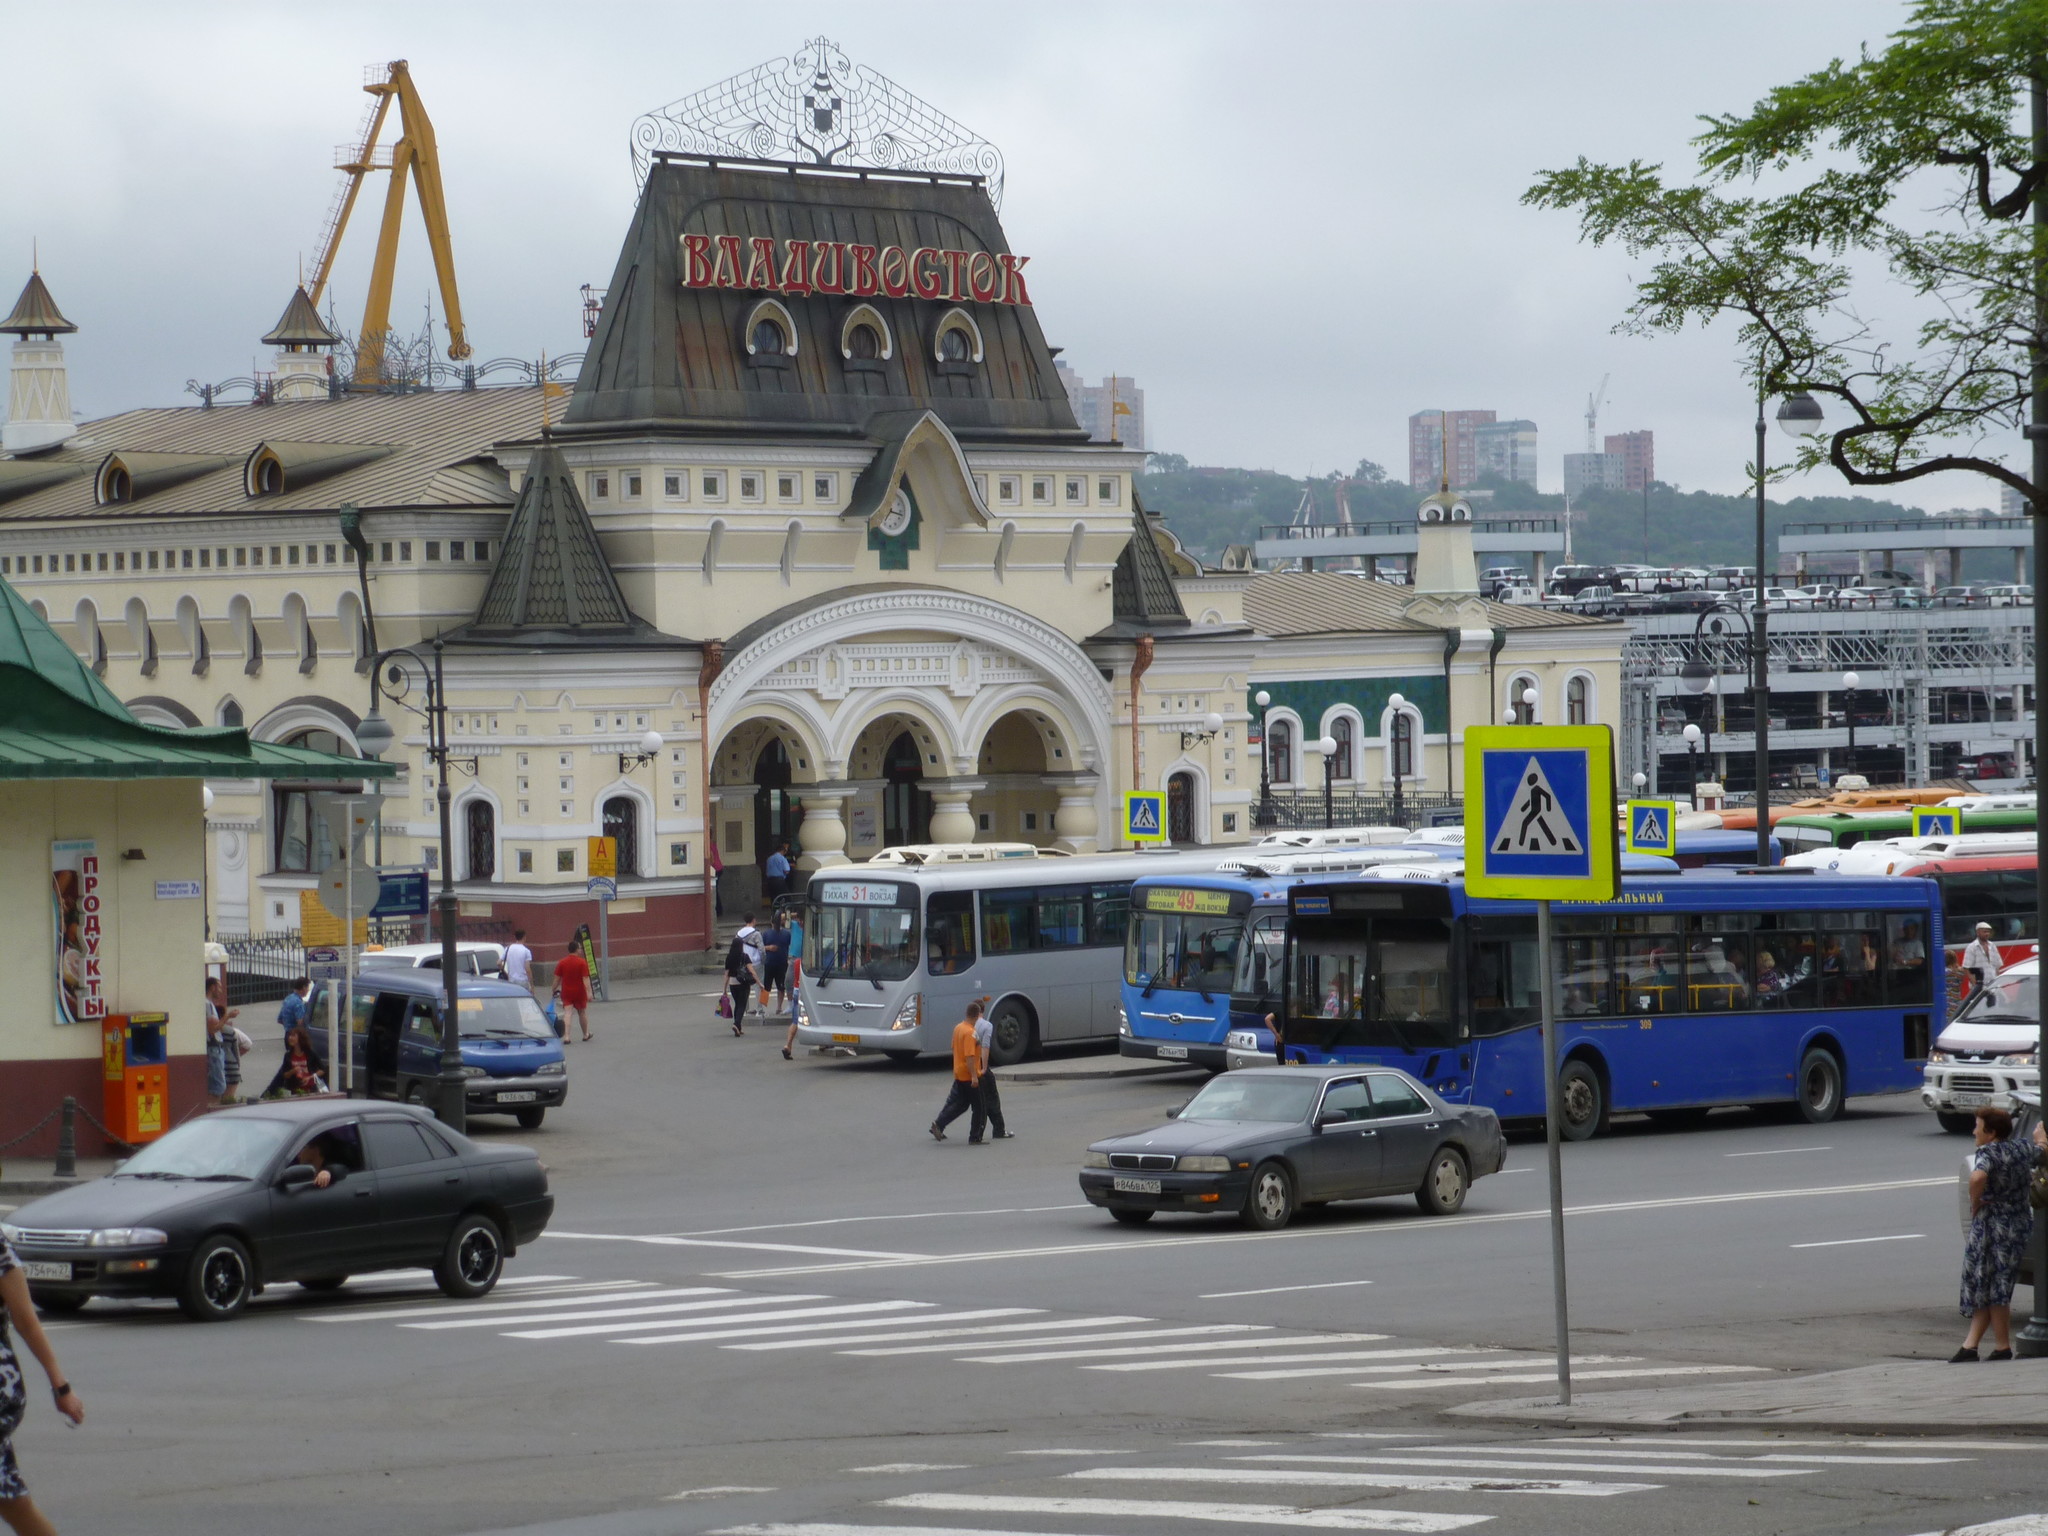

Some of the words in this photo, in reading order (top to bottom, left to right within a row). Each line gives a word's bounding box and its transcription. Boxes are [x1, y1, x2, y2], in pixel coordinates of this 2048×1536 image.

[680, 233, 1033, 307] ВЛАДИВОСТОК
[824, 891, 849, 900] ТИХАЯ
[851, 886, 868, 901] 31
[1177, 890, 1195, 911] 49
[1207, 892, 1230, 901] ЦЕНТР
[82, 856, 106, 1017] ПРОДУКТЫ
